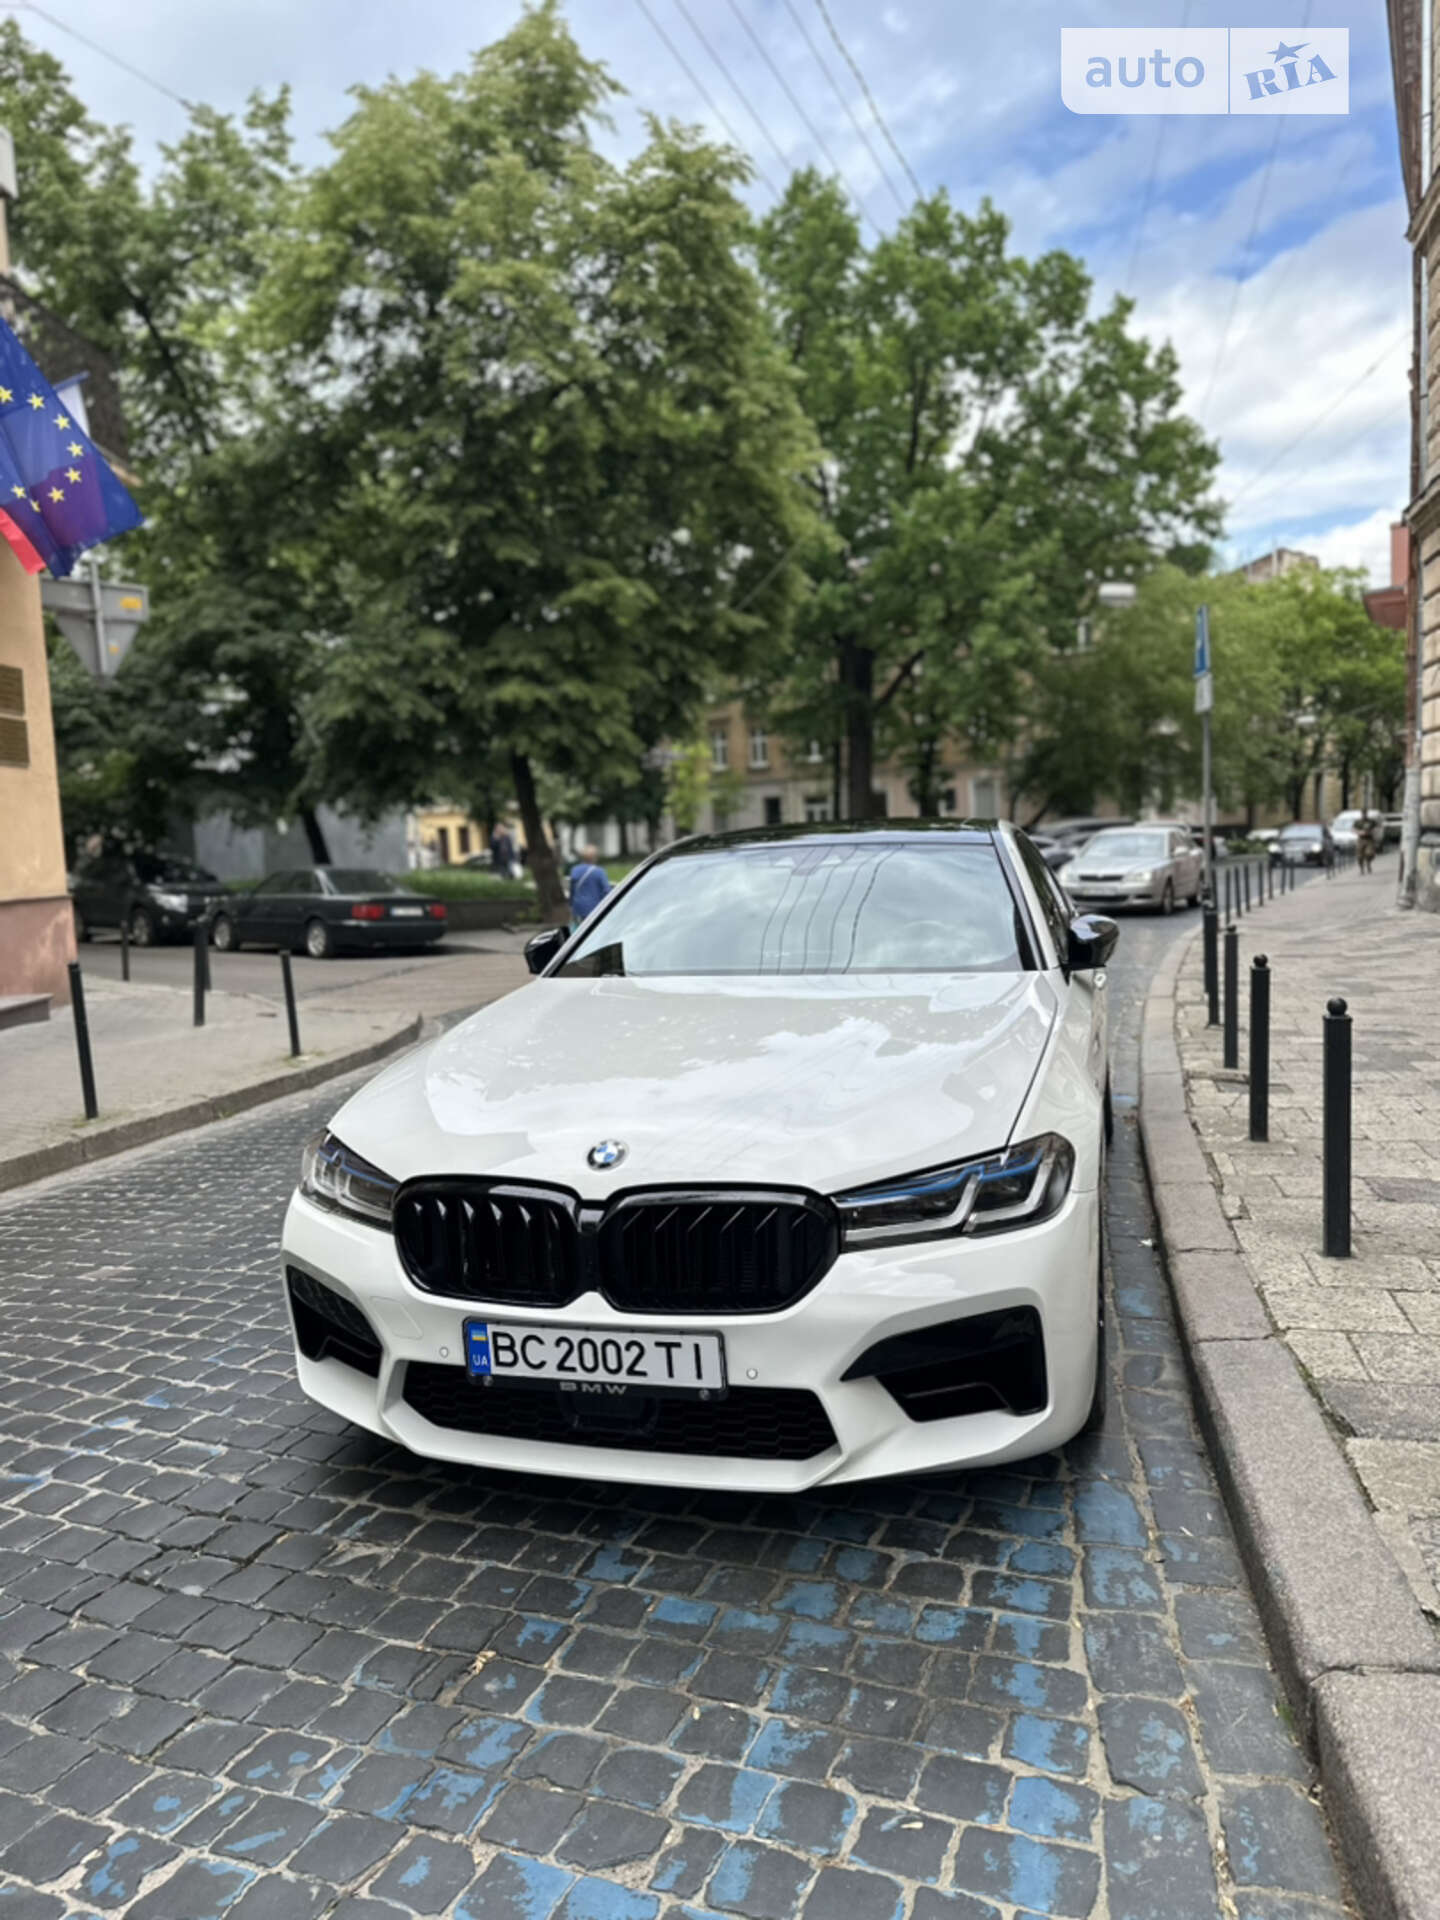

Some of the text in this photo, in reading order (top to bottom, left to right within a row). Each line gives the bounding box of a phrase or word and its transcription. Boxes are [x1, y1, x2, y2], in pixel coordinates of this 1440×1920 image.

[472, 1353, 488, 1366] UA
[554, 1336, 648, 1377] 2002
[560, 1381, 627, 1395] BMW
